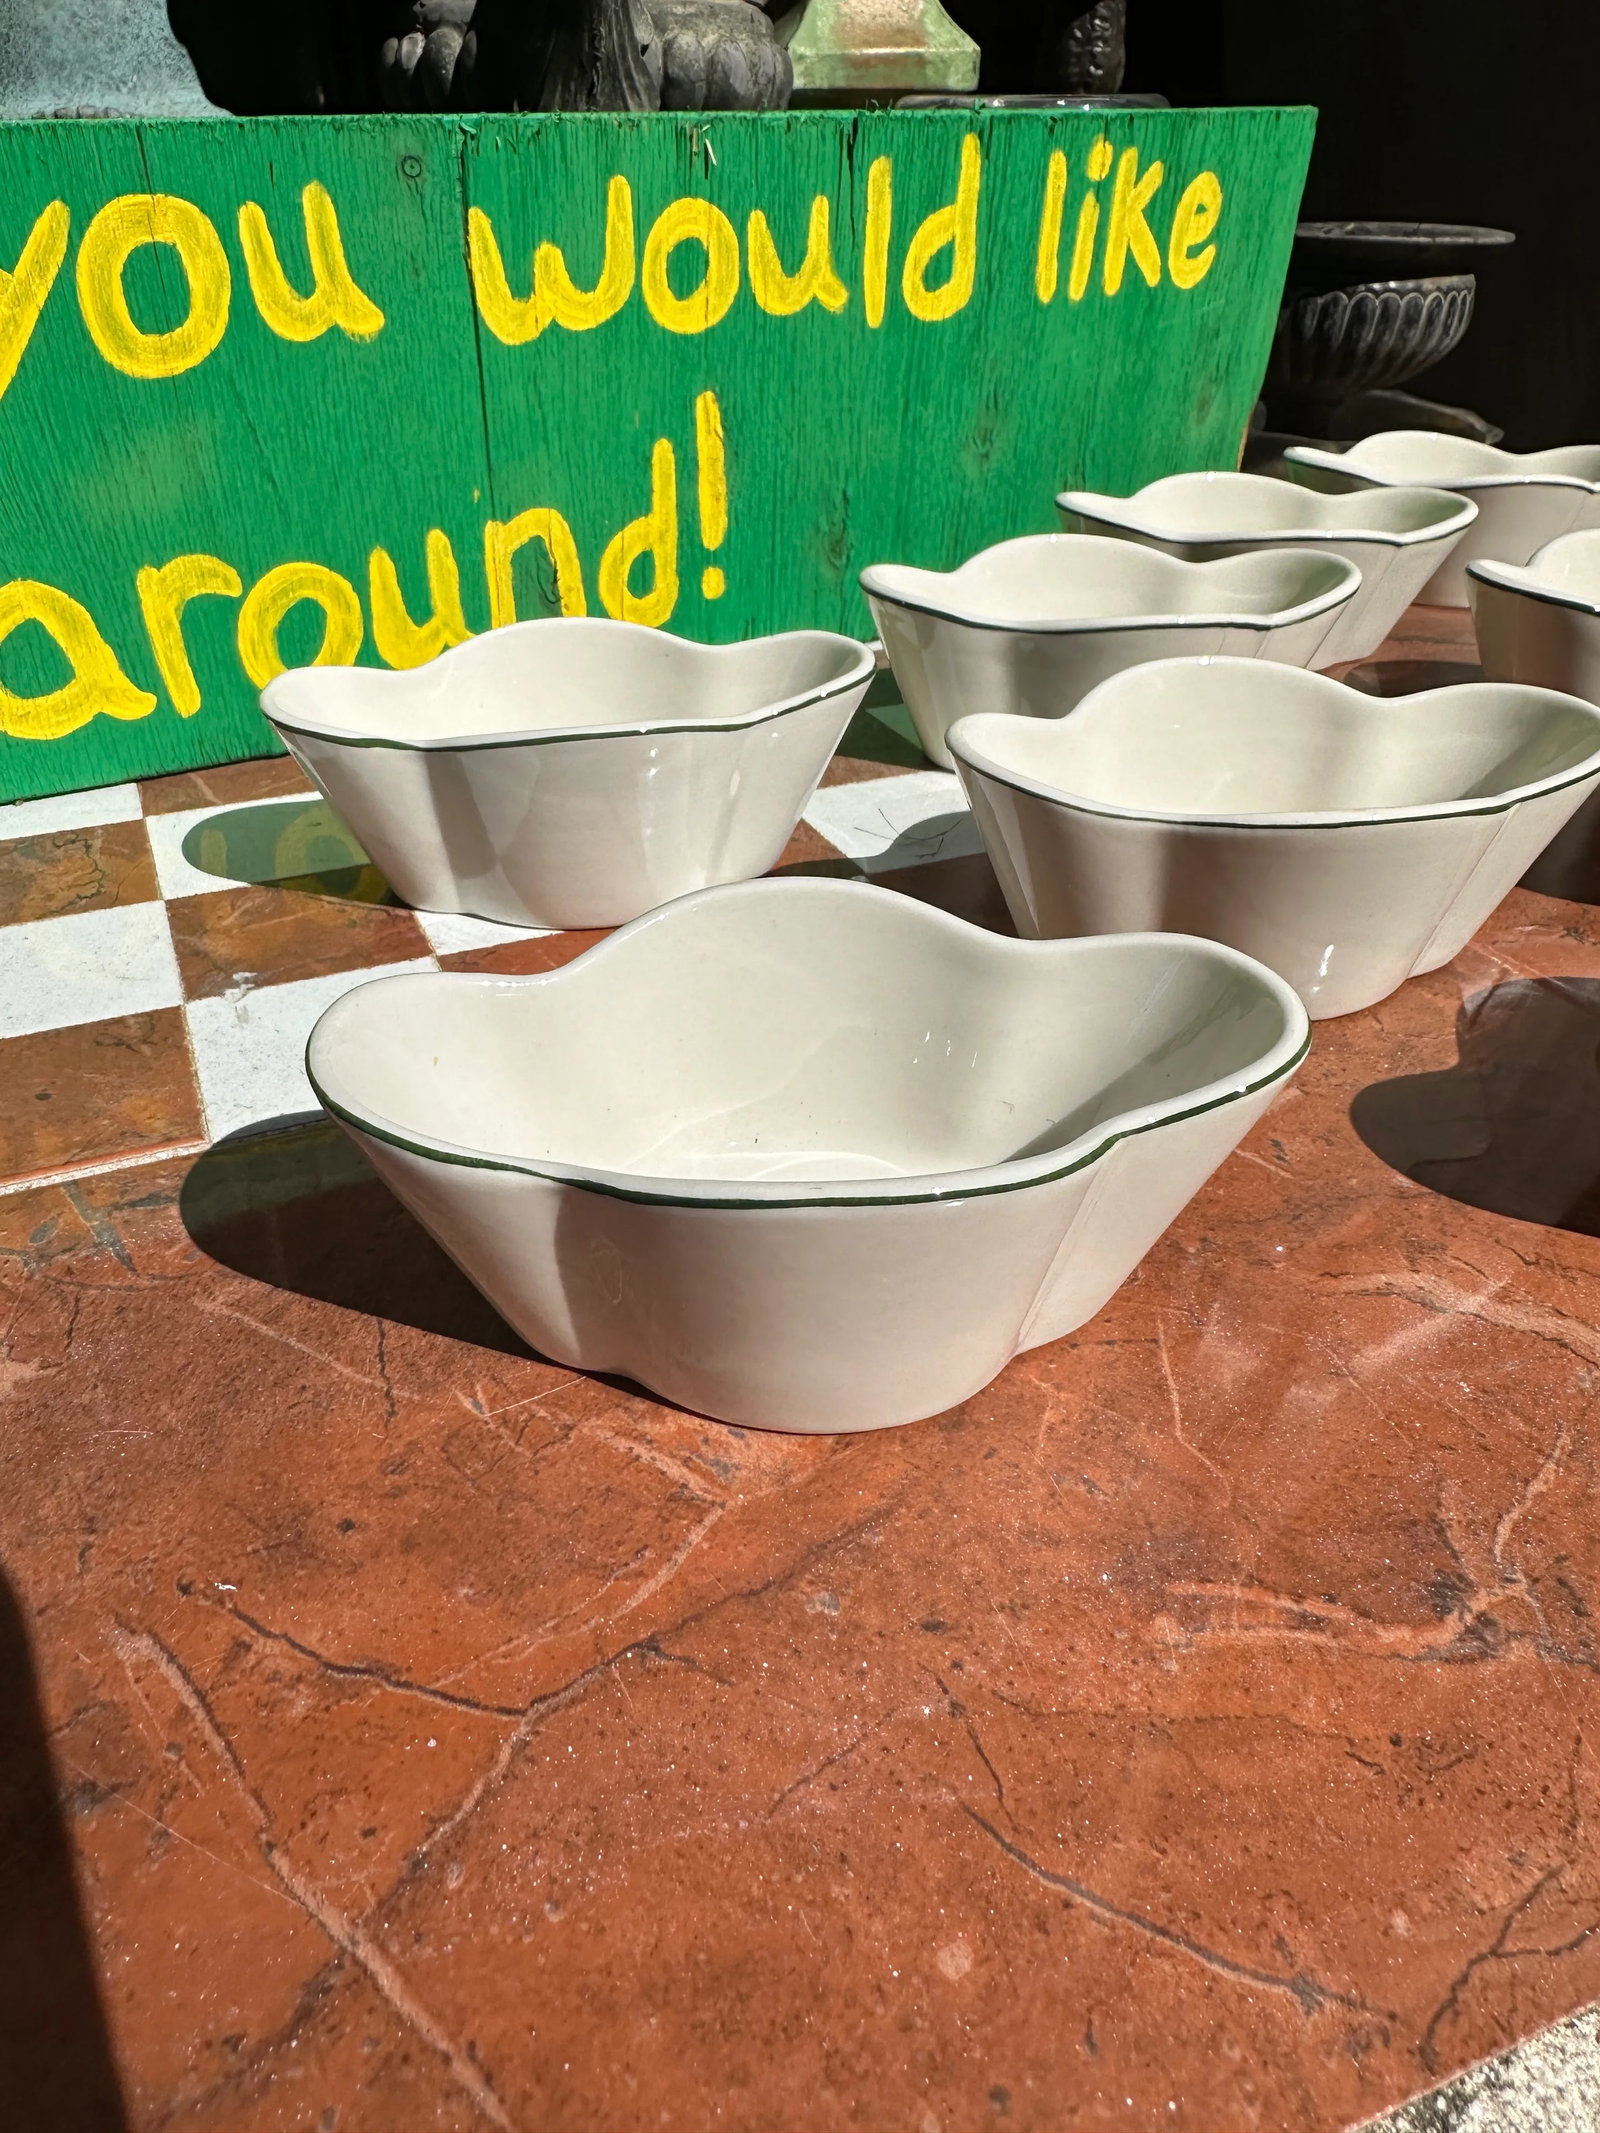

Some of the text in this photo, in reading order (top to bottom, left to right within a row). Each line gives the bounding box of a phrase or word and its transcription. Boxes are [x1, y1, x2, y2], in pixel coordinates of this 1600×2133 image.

[467, 132, 982, 346] would
[1035, 136, 1223, 305] like
[0, 390, 728, 741] around!
